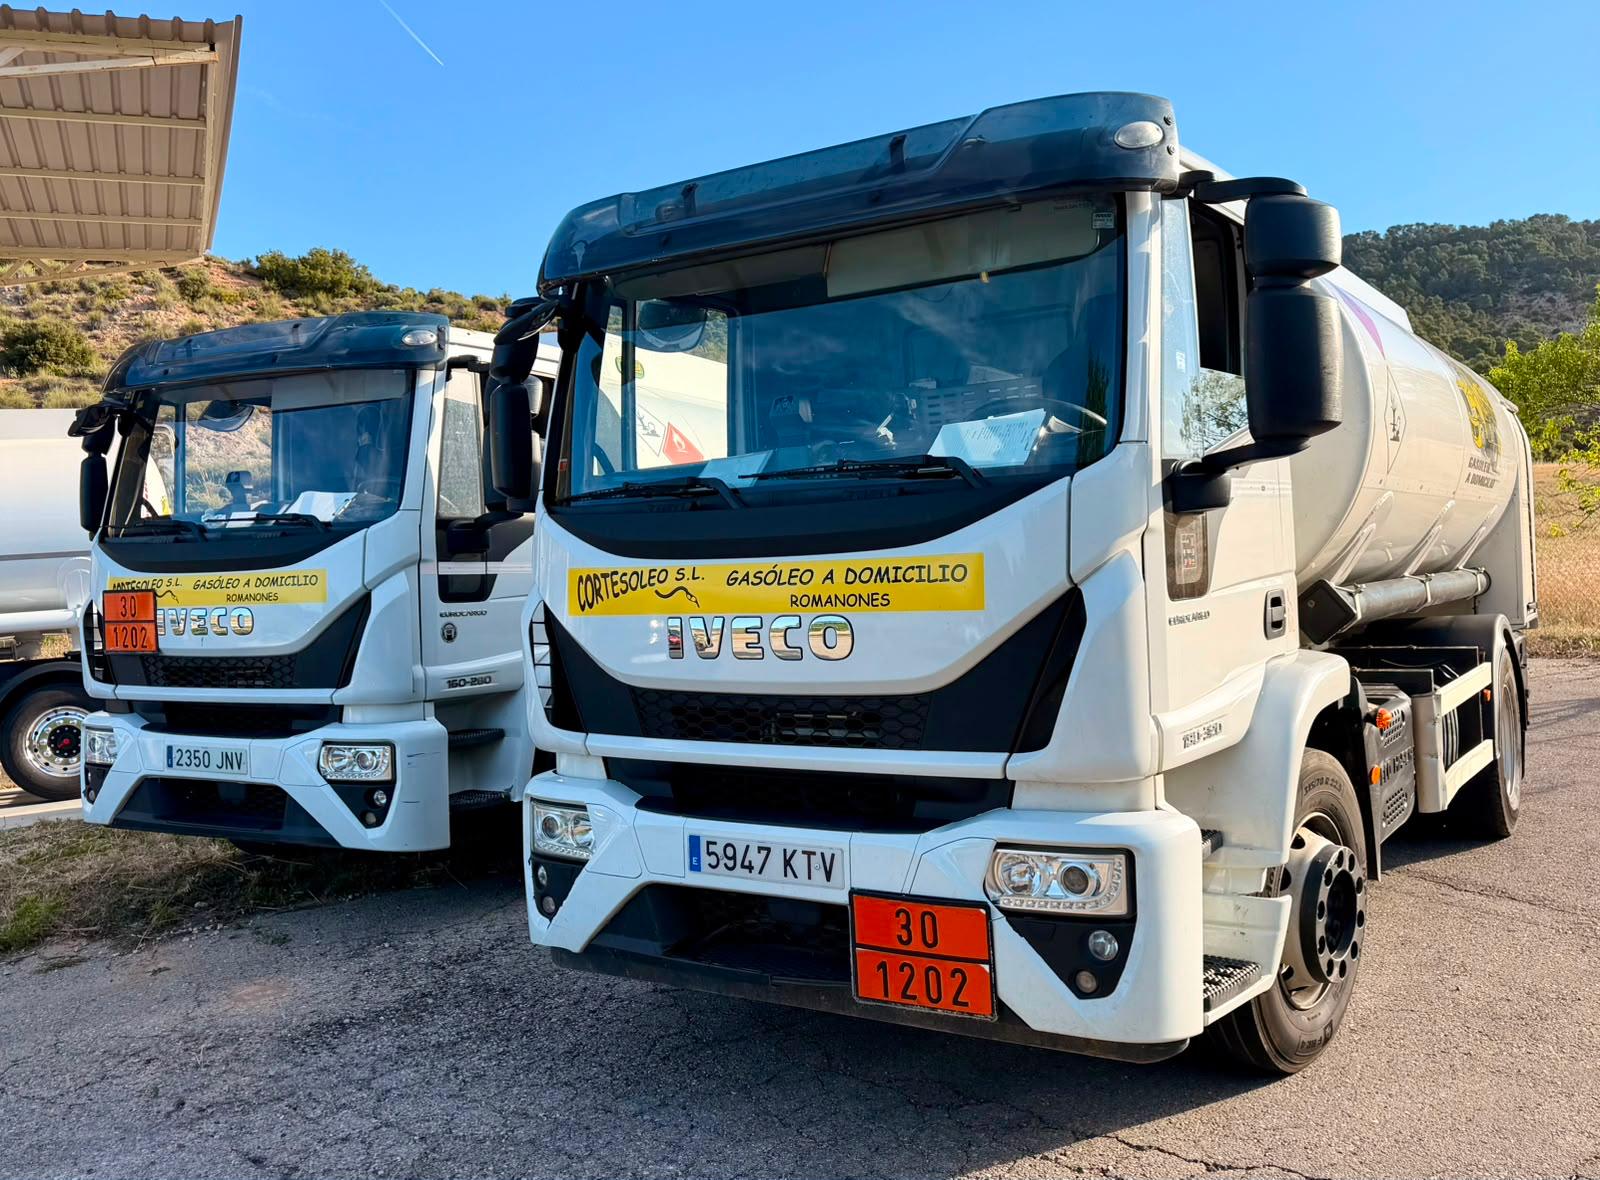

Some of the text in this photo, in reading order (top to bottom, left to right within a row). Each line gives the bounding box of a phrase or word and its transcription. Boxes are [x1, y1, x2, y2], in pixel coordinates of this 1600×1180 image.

[166, 576, 183, 587] S.L.
[193, 574, 319, 590] GASÓLEO A DOMICILIO
[726, 563, 968, 586] GASÓLEO A DOMICILIO
[226, 592, 279, 602] ROMANONES
[577, 566, 705, 612] CORTESOLEO S.L.
[790, 592, 891, 608] ROMANONES
[120, 595, 137, 618] 30
[156, 606, 255, 636] IVECO
[113, 626, 148, 649] 1202
[667, 614, 855, 661] IVECO
[176, 748, 243, 770] 2350 JNV
[705, 840, 771, 875] 5947
[783, 848, 836, 883] KTV
[894, 908, 939, 949] 30
[875, 959, 970, 1008] 1202
